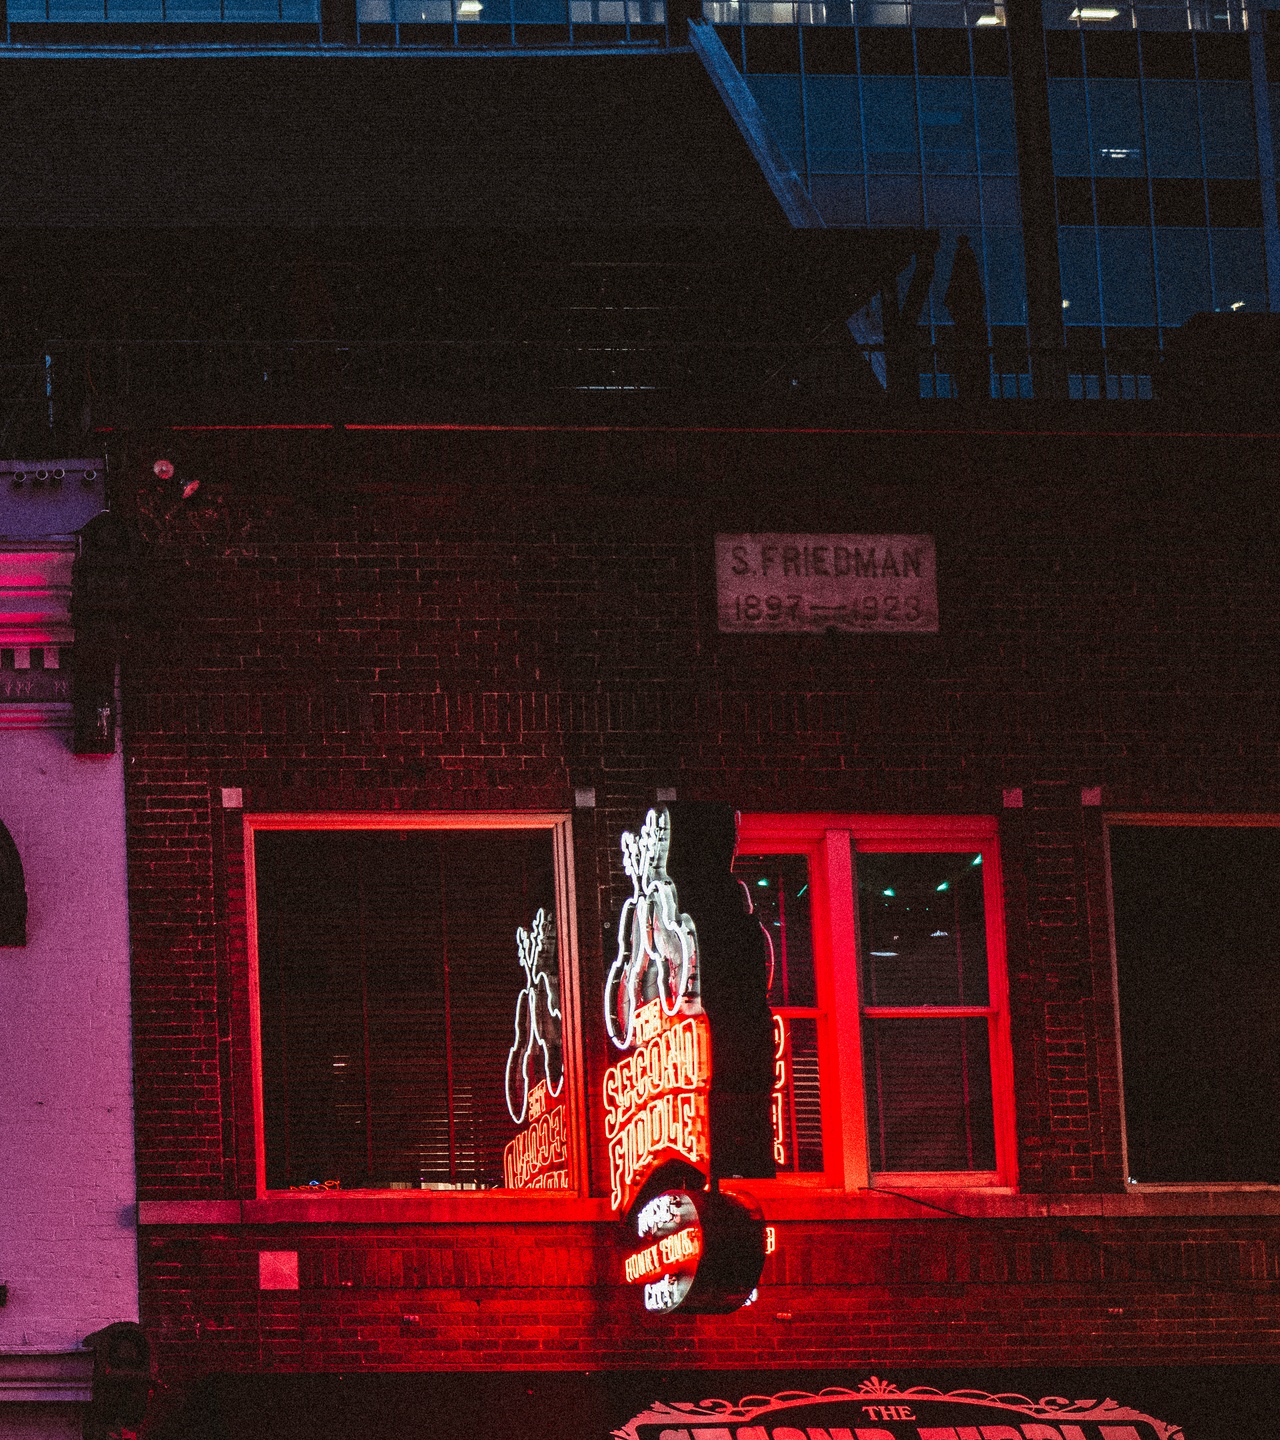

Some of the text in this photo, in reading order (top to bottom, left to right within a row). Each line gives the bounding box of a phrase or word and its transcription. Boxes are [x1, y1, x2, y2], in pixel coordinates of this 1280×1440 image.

[603, 1018, 697, 1138] SECOND
[608, 1094, 697, 1211] FIDDLE
[625, 1244, 660, 1282] HONKY
[862, 1405, 916, 1421] THE
